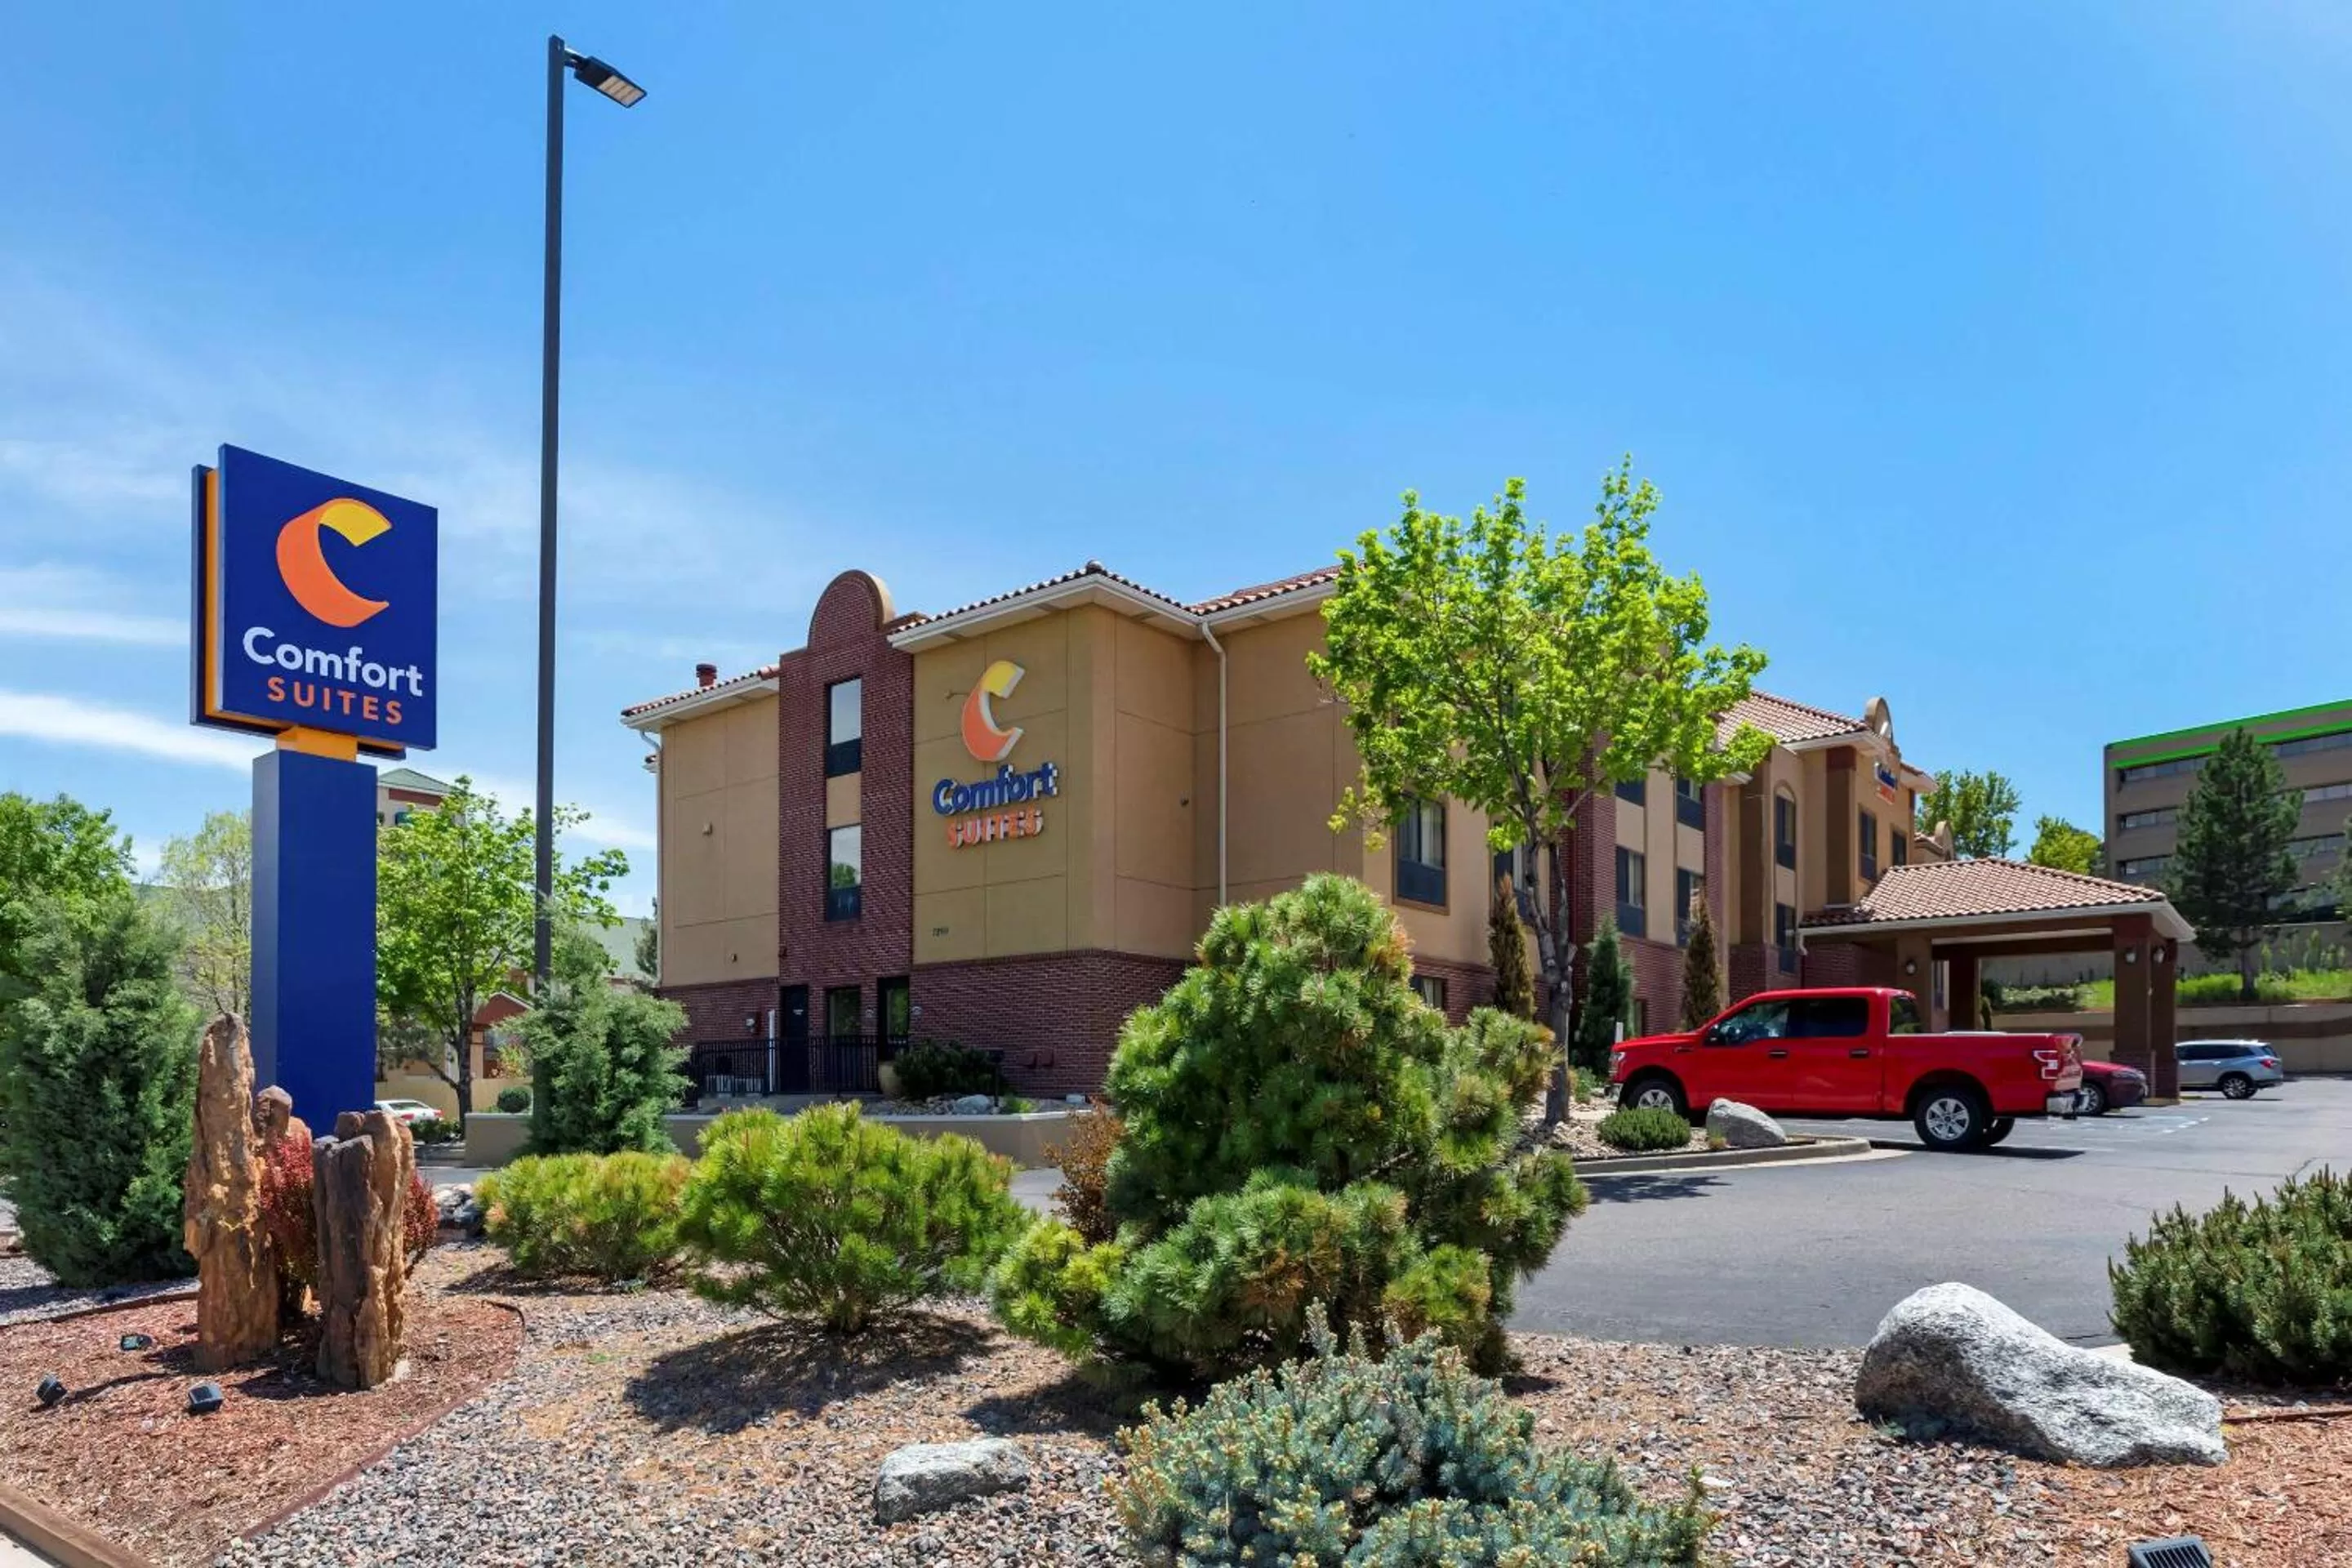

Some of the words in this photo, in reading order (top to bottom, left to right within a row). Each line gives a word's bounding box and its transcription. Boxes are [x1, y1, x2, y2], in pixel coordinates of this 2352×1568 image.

[243, 626, 423, 697] Comfort
[267, 676, 403, 724] SUITES
[933, 761, 1058, 815] Comfort
[947, 804, 1043, 849] SUITES
